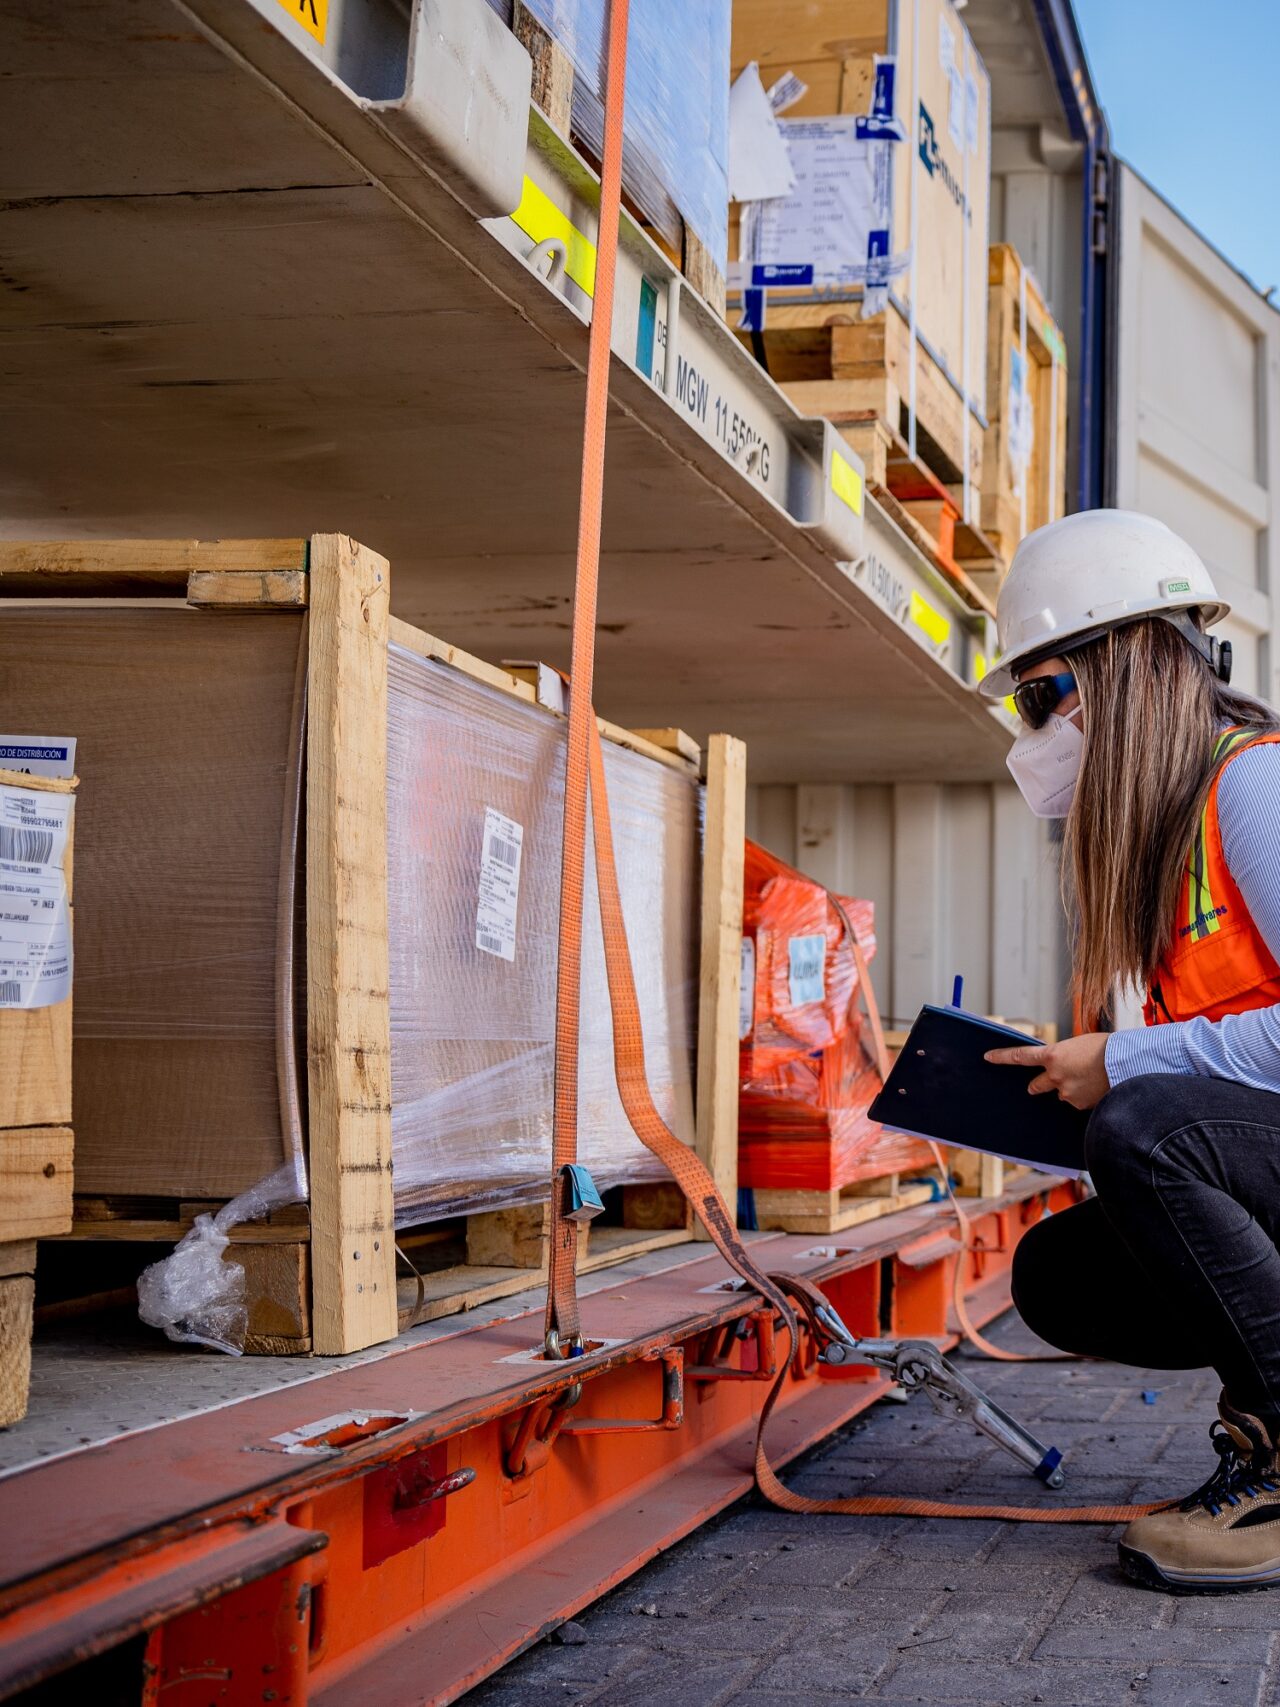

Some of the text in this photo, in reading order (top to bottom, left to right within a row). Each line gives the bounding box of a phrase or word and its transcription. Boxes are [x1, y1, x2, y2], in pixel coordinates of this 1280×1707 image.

[676, 354, 770, 482] MGW 11,55G
[1169, 583, 1190, 591] MSA
[7, 748, 16, 757] DE
[17, 749, 62, 759] DISTRIBUCIÓN
